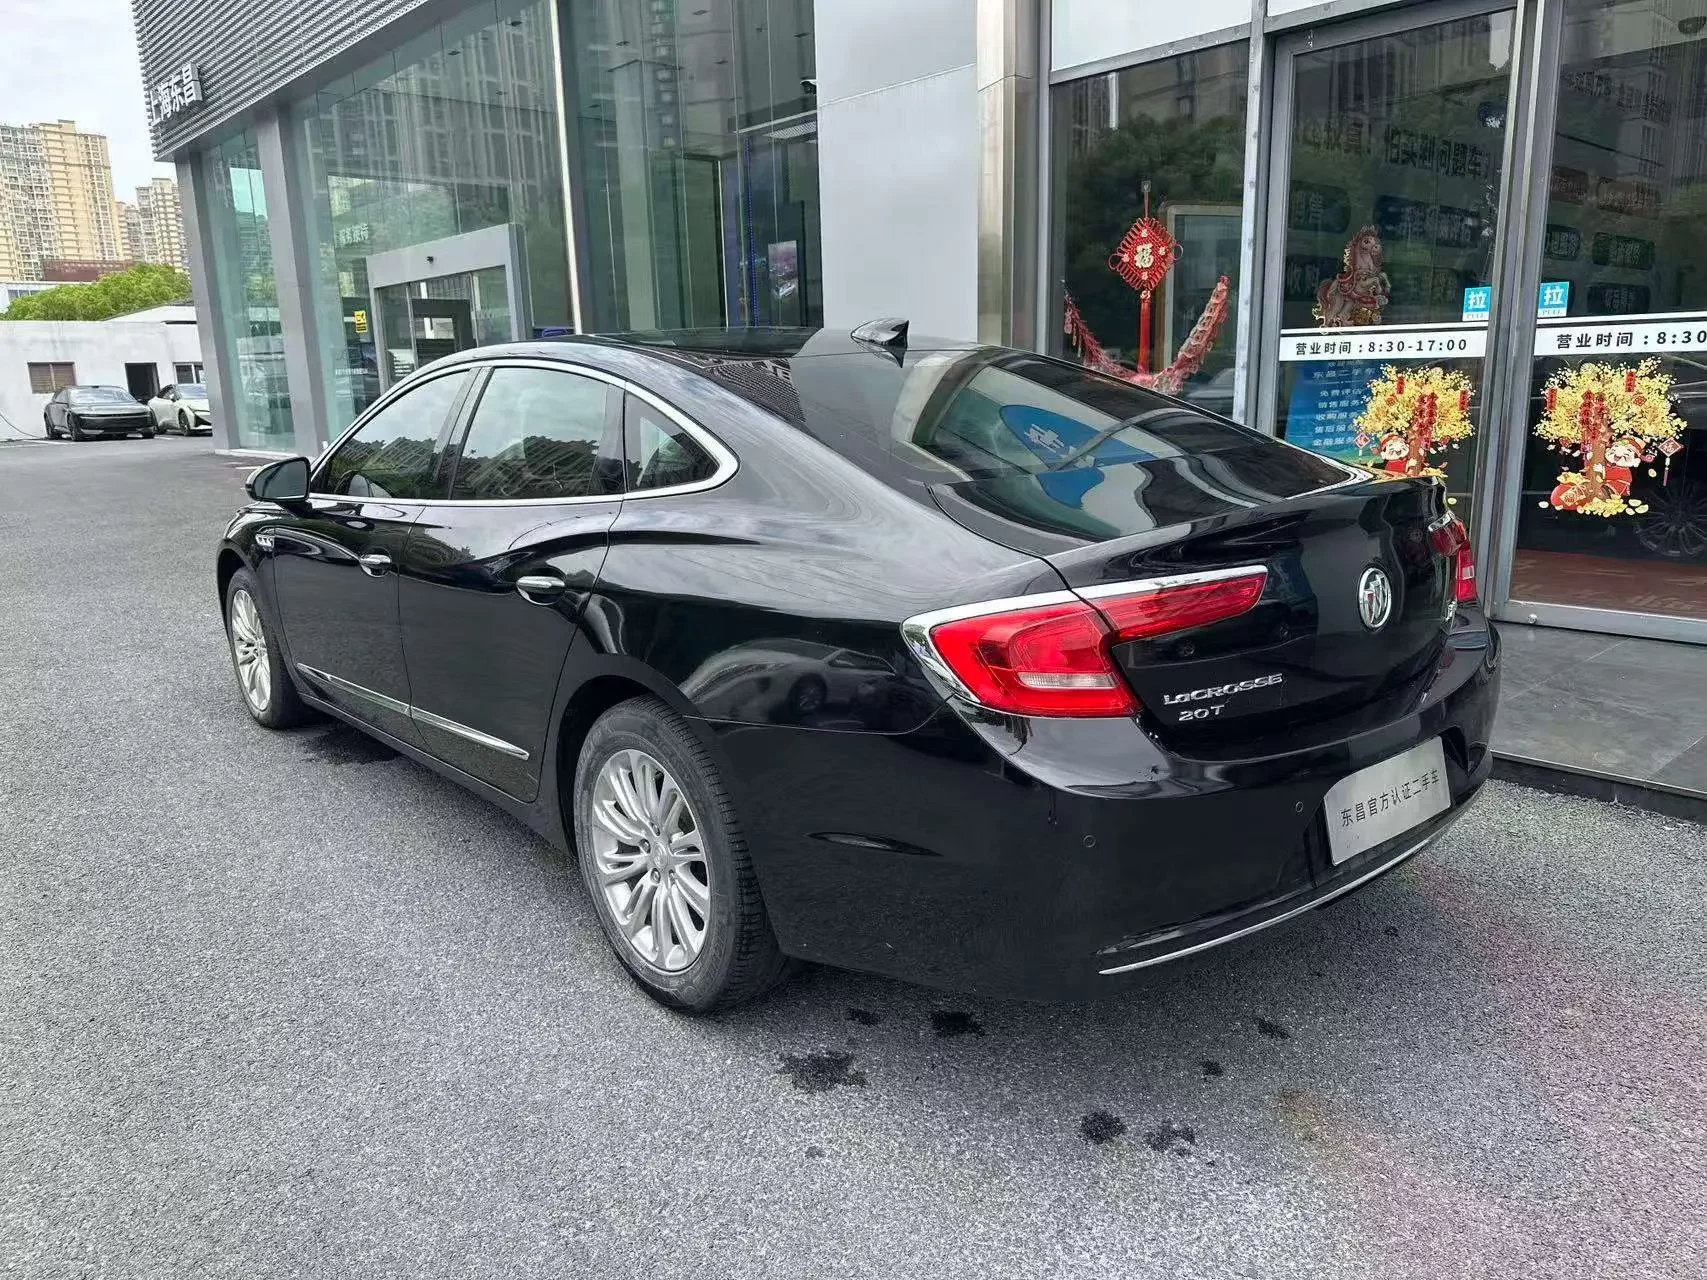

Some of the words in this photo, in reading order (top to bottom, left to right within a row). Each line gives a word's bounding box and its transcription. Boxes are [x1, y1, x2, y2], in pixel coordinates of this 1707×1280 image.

[149, 63, 202, 126] 上海东昌
[1134, 243, 1154, 268] 福
[1468, 291, 1487, 309] 拉
[1544, 286, 1564, 305] 拉
[1178, 705, 1225, 722] 20T
[1341, 768, 1440, 829] 东昌官方认证二手车
